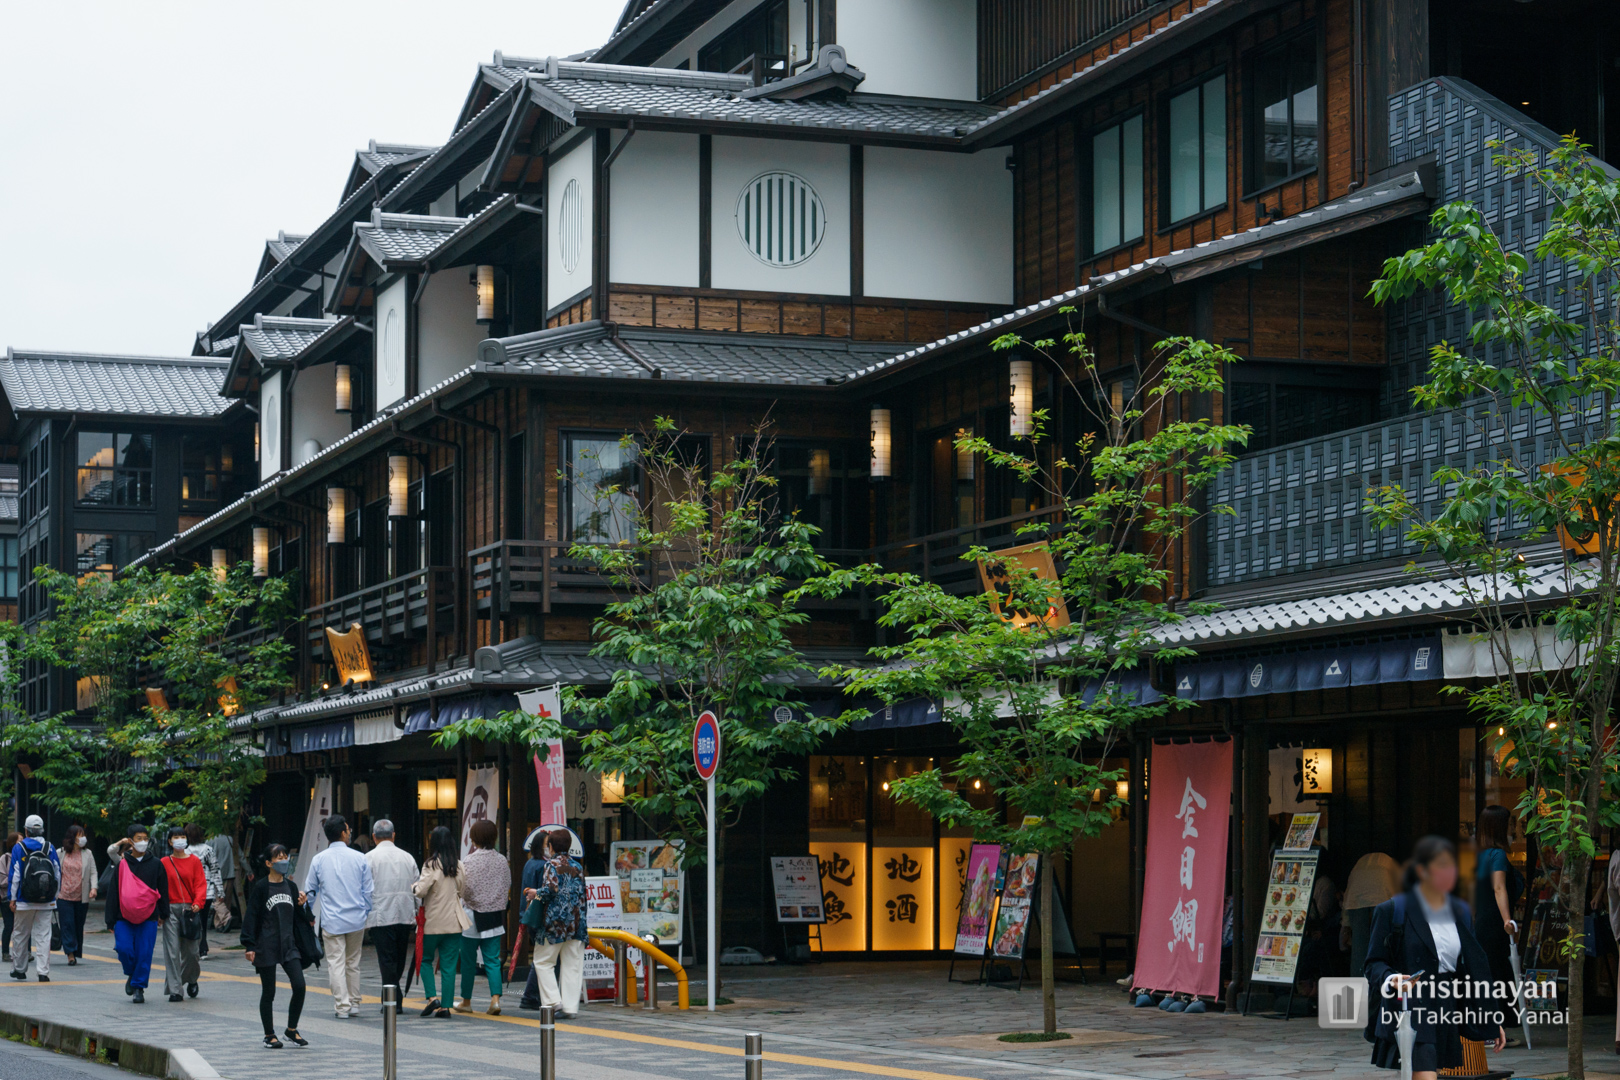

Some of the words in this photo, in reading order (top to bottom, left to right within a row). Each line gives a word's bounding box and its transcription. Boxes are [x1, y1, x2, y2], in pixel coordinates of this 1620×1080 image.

[697, 736, 716, 754] 消防用水
[1305, 758, 1318, 790] とくぞう
[819, 852, 855, 925] 地魚
[884, 853, 922, 924] 地酒
[1168, 776, 1207, 952] 金目鯛
